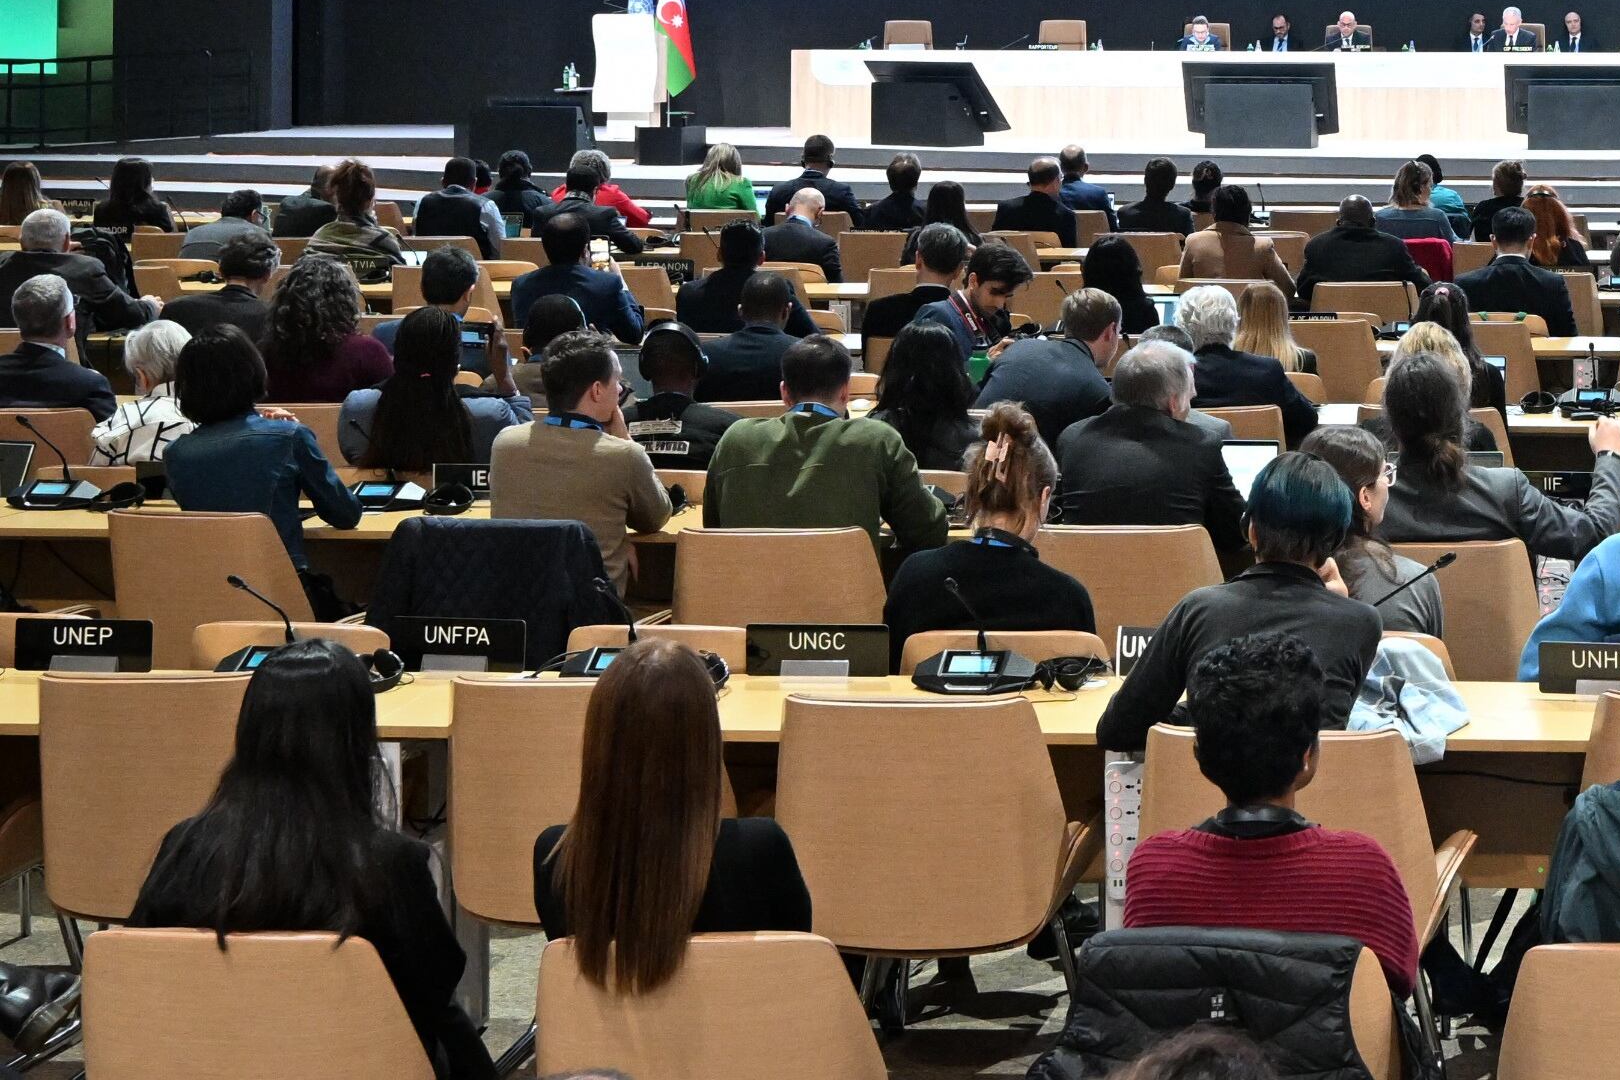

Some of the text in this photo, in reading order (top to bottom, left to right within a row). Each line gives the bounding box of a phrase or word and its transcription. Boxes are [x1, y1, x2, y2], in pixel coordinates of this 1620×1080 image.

[346, 260, 377, 269] ATVIA
[1543, 477, 1563, 492] IIF
[53, 626, 114, 646] UNEP
[424, 625, 490, 646] UNFPA
[789, 631, 846, 650] UNGC
